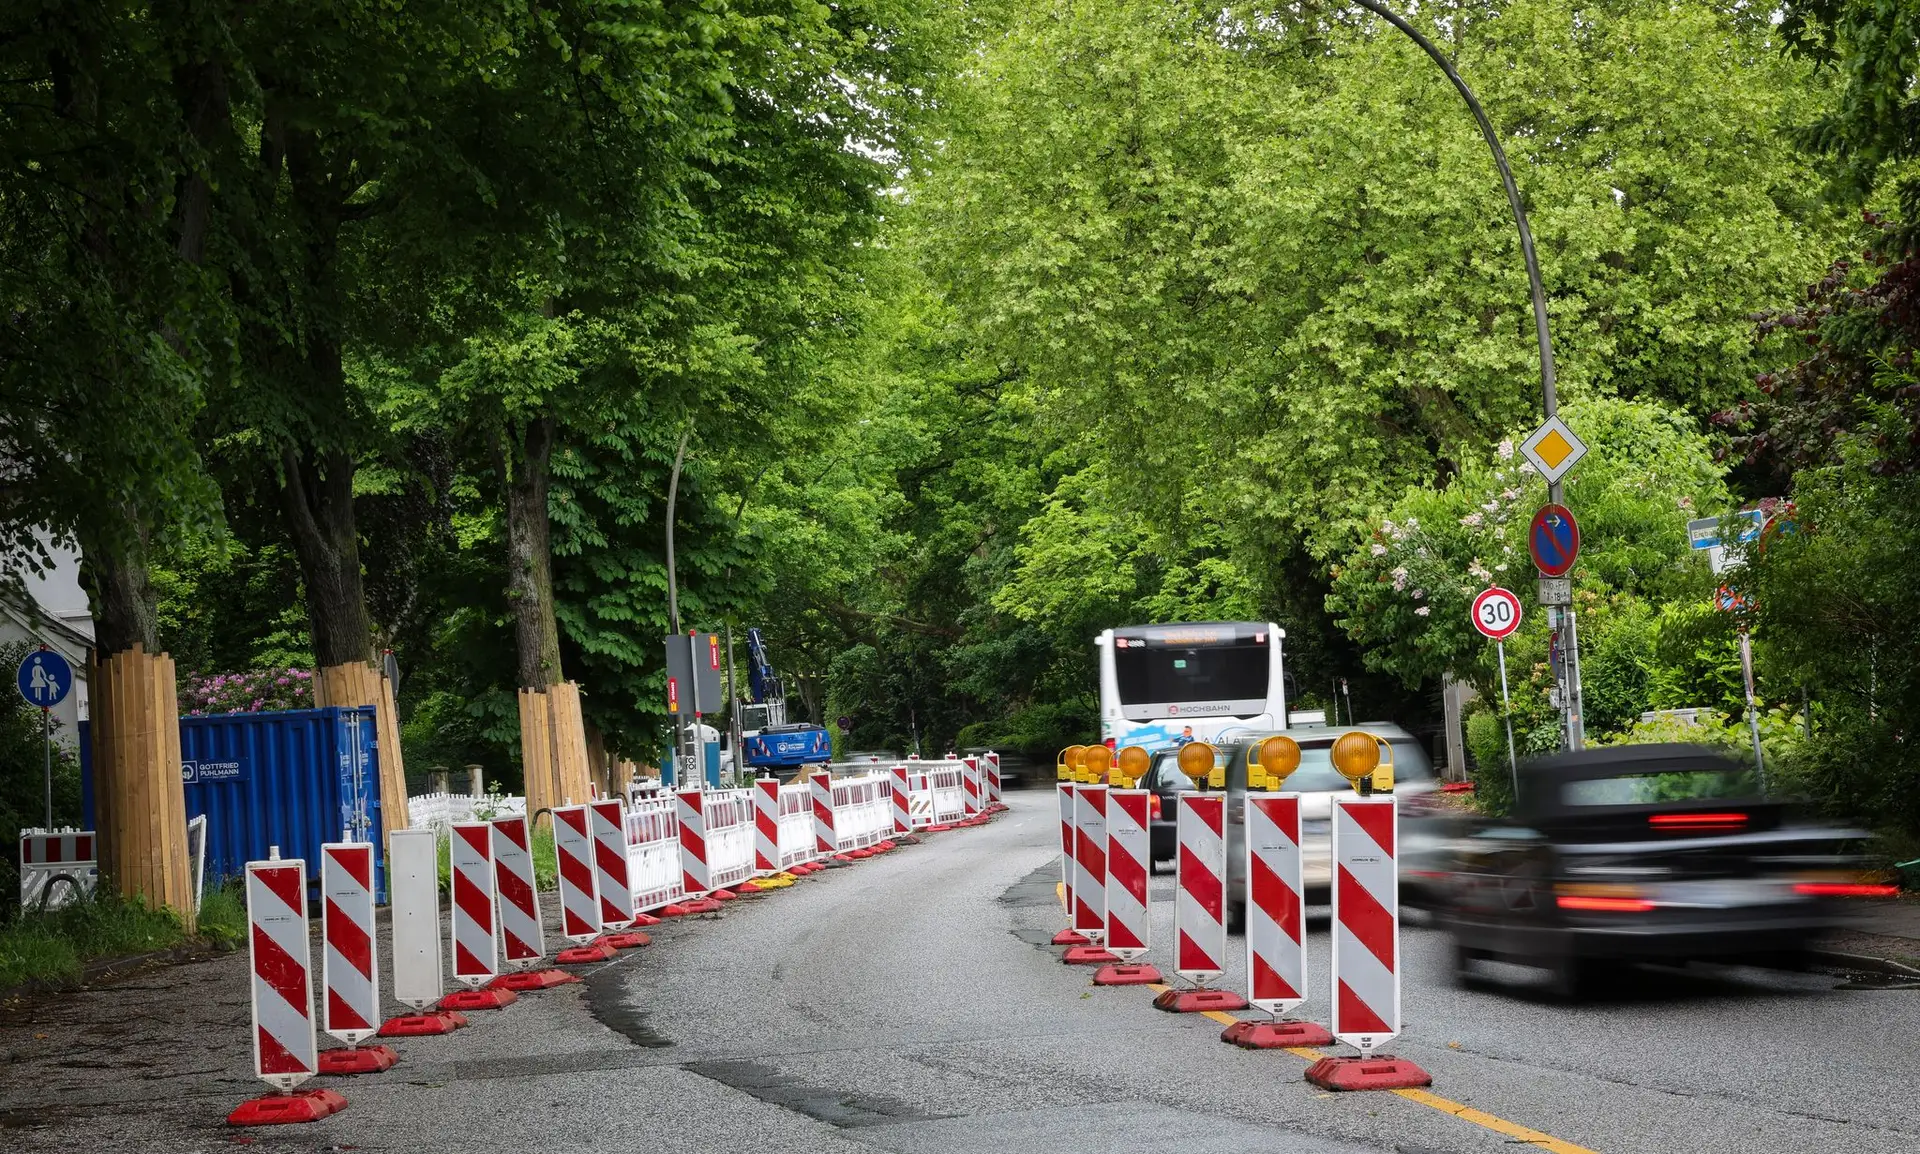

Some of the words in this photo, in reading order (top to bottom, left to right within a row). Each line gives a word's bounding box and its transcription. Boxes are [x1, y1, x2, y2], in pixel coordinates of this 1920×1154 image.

[1482, 601, 1510, 624] 30
[1180, 704, 1231, 714] HOCHBAHN
[199, 762, 239, 771] GOTTFRIED
[200, 769, 239, 777] PUHLMANN
